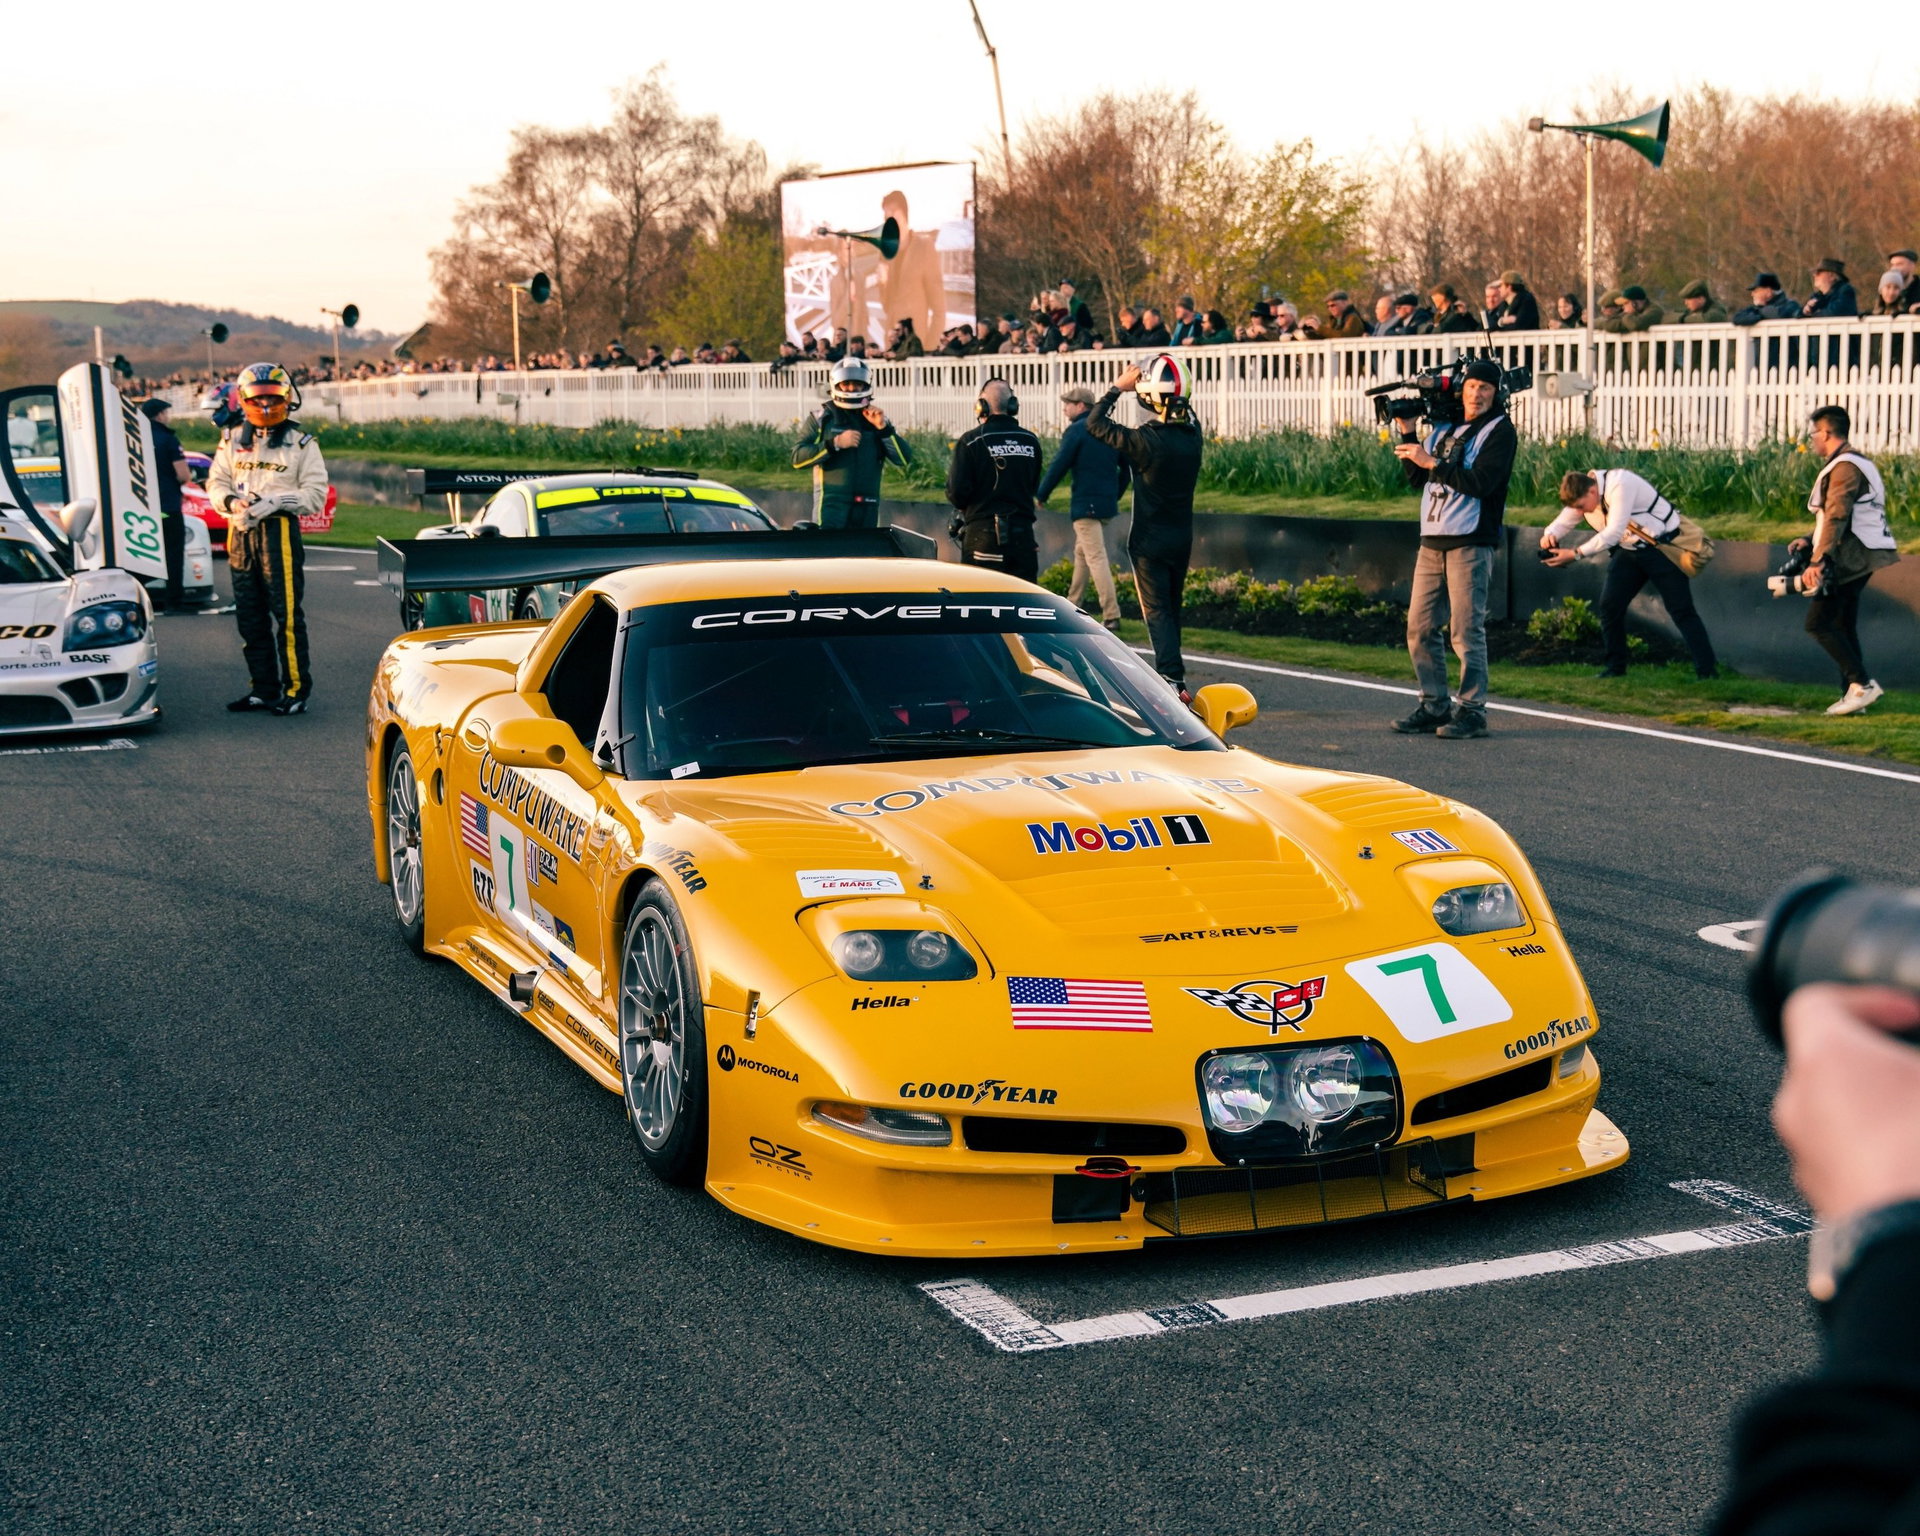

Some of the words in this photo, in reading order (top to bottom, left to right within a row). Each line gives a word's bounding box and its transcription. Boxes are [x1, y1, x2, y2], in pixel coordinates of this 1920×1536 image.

[988, 445, 1034, 456] HISTORICS
[456, 474, 502, 483] ASTON
[1427, 491, 1449, 523] 27
[123, 510, 162, 563] 163
[82, 593, 117, 604] Hella
[691, 604, 1057, 629] CORVETTE
[69, 653, 111, 664] BASF
[480, 749, 589, 864] COMPUWARE
[829, 769, 1261, 819] COMPUWARE
[1026, 816, 1161, 855] Mobil
[499, 834, 516, 911] 7
[840, 880, 873, 888] MANS
[473, 866, 495, 915] GTS
[1163, 926, 1277, 942] ART&REVS
[1507, 943, 1547, 957] Hella
[1376, 953, 1458, 1025] 7
[851, 995, 910, 1010] Hella
[565, 1013, 623, 1074] CORVETTE
[737, 1056, 799, 1083] MOTOROLA
[755, 1159, 812, 1181] RACING
